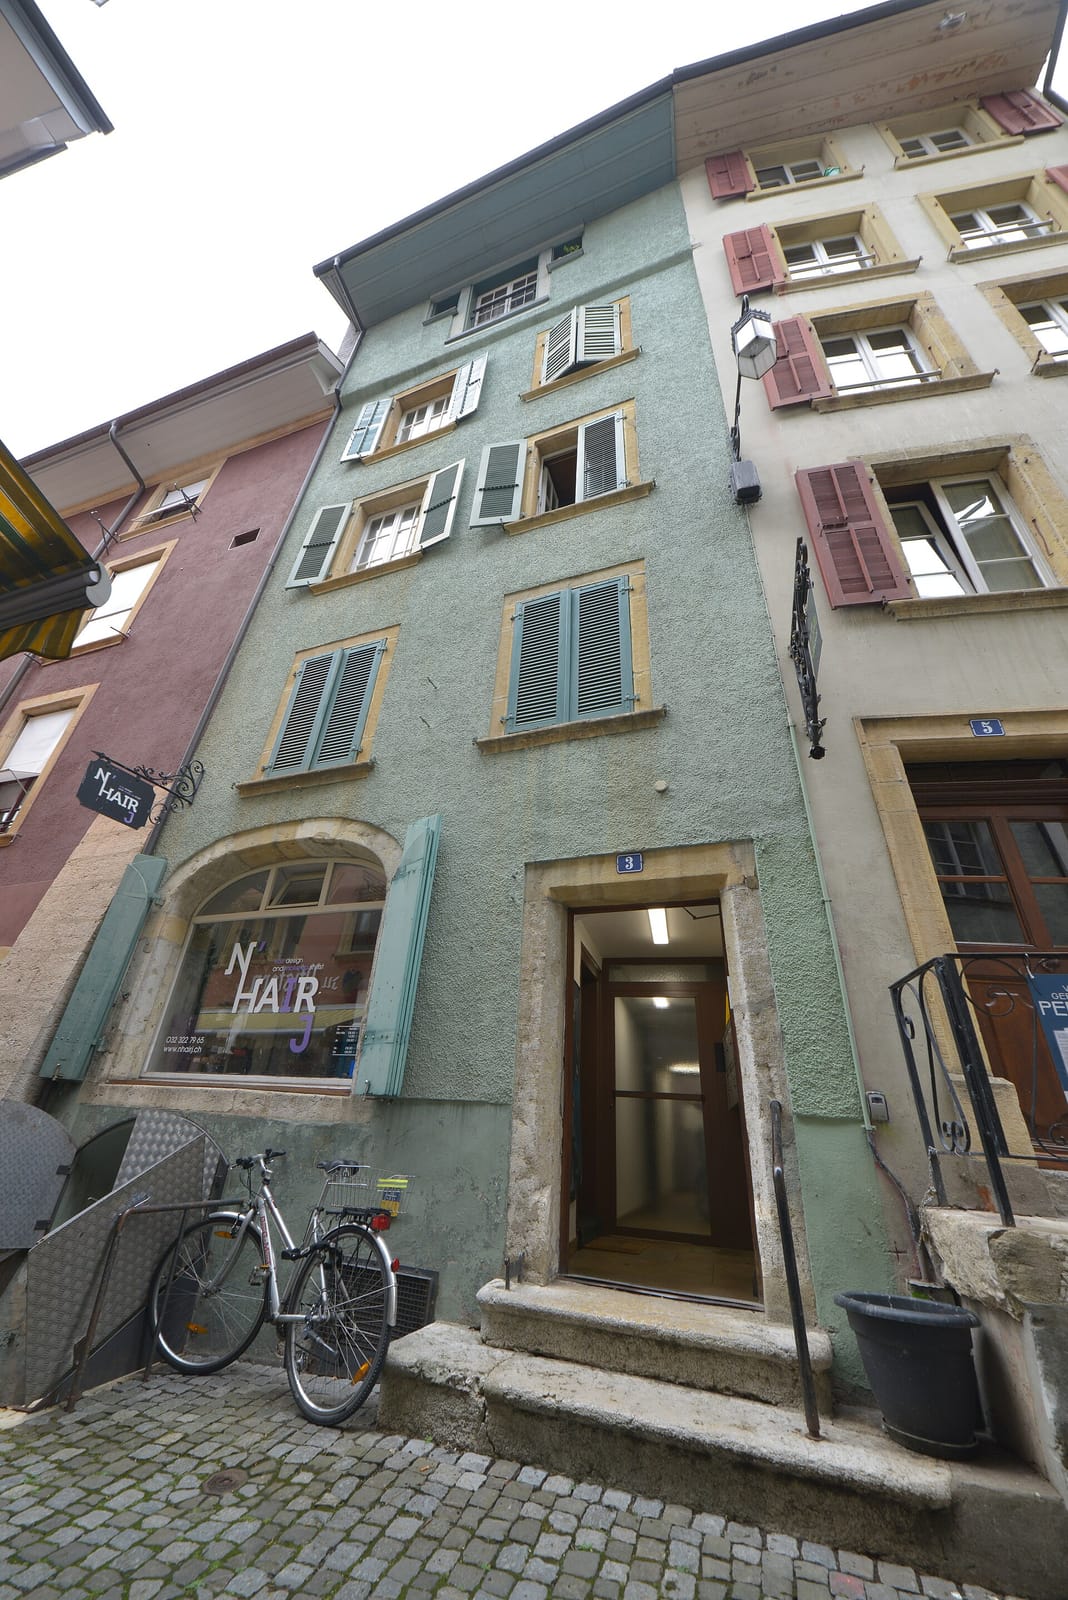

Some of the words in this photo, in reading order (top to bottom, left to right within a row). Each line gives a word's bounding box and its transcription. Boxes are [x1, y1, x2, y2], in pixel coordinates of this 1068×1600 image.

[981, 721, 993, 734] 5
[98, 787, 139, 813] HAIR
[123, 811, 136, 824] J
[625, 856, 634, 870] 3
[231, 976, 319, 1013] HAIR
[166, 1036, 177, 1044] 032
[178, 1036, 189, 1044] 322
[289, 1014, 314, 1054] J
